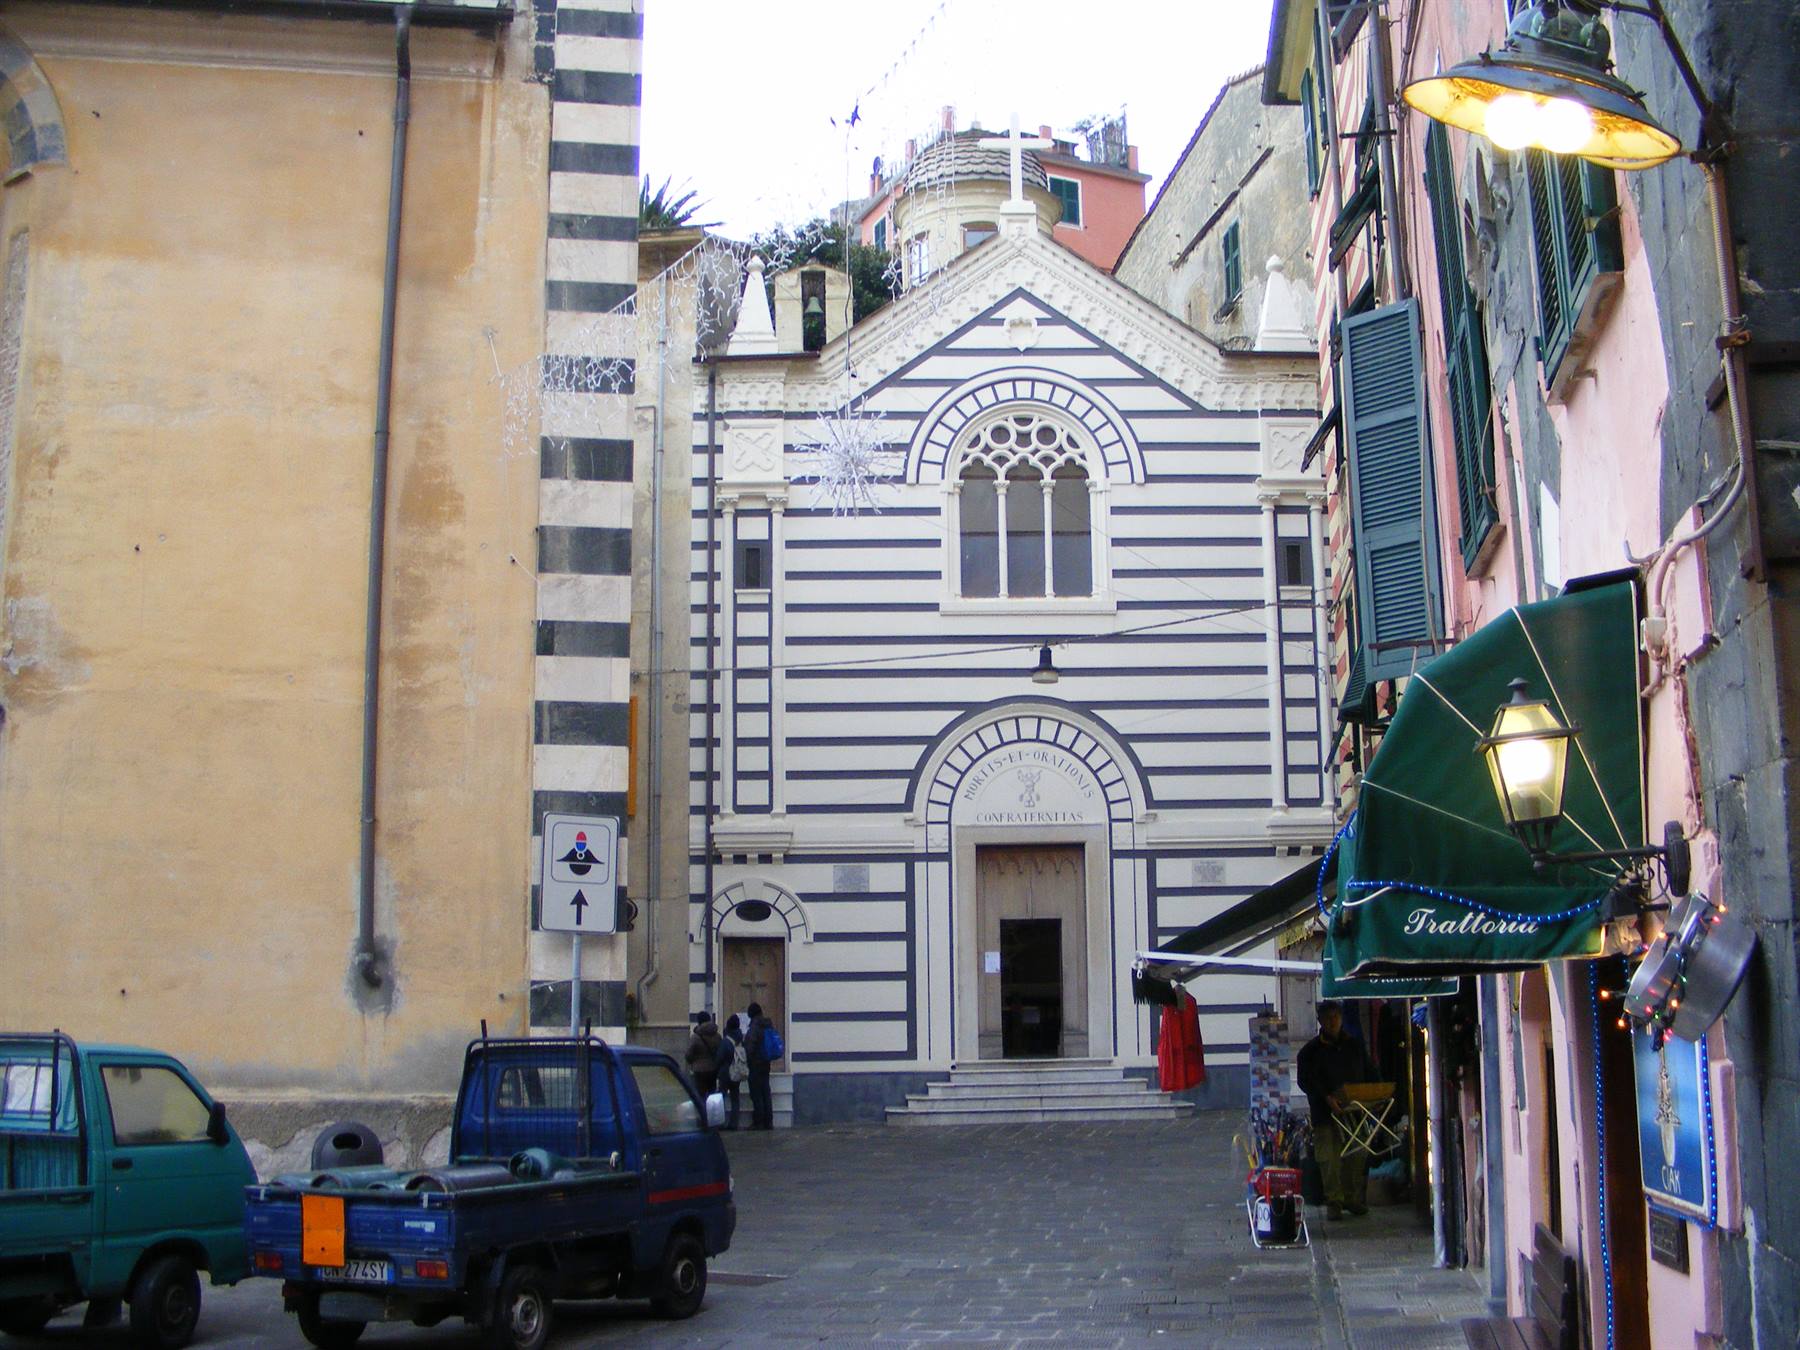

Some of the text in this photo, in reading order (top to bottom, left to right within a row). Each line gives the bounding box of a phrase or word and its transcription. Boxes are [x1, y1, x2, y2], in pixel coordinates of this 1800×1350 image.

[976, 811, 1084, 823] CONFRATERNITAS
[1403, 908, 1539, 935] Trattoria
[1661, 1165, 1682, 1195] CIAK
